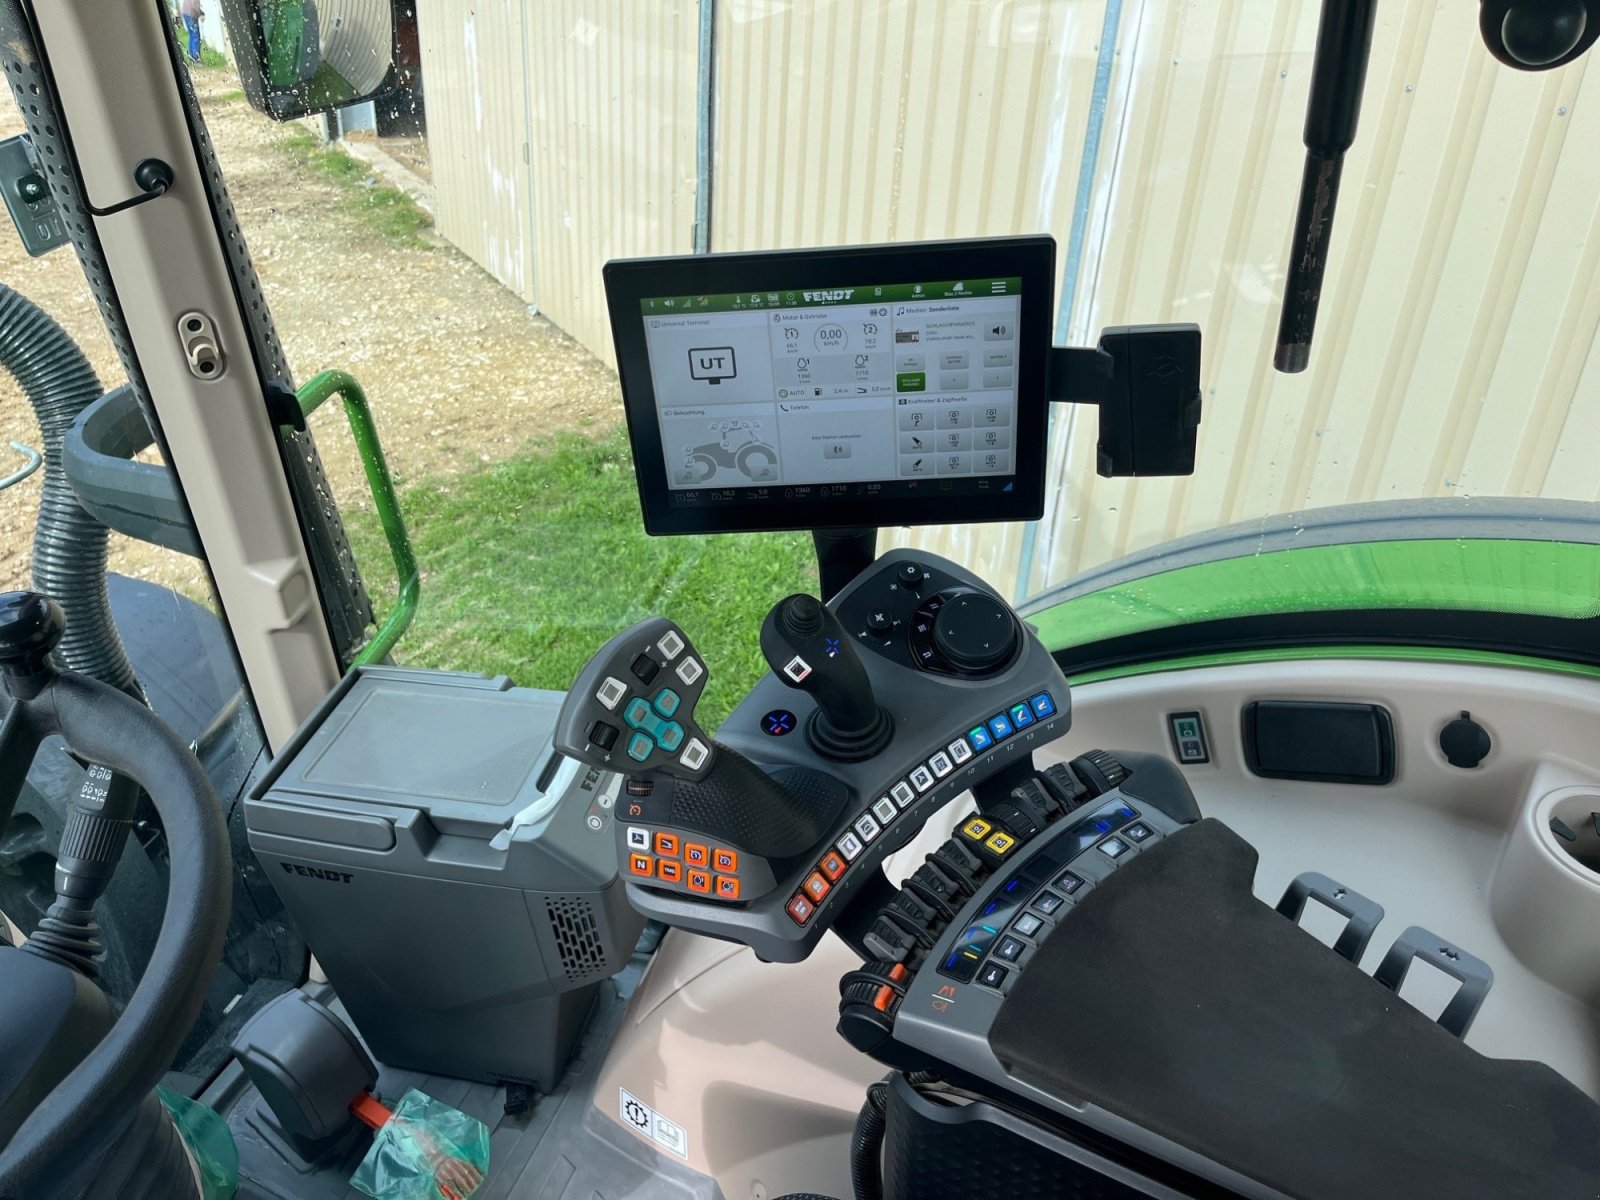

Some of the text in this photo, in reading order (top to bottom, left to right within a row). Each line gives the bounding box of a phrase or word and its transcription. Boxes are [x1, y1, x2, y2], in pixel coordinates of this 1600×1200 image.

[803, 290, 854, 302] FENDT
[820, 329, 842, 340] 0,00
[700, 357, 725, 370] UT
[637, 861, 645, 869] N
[280, 862, 354, 884] FENDT
